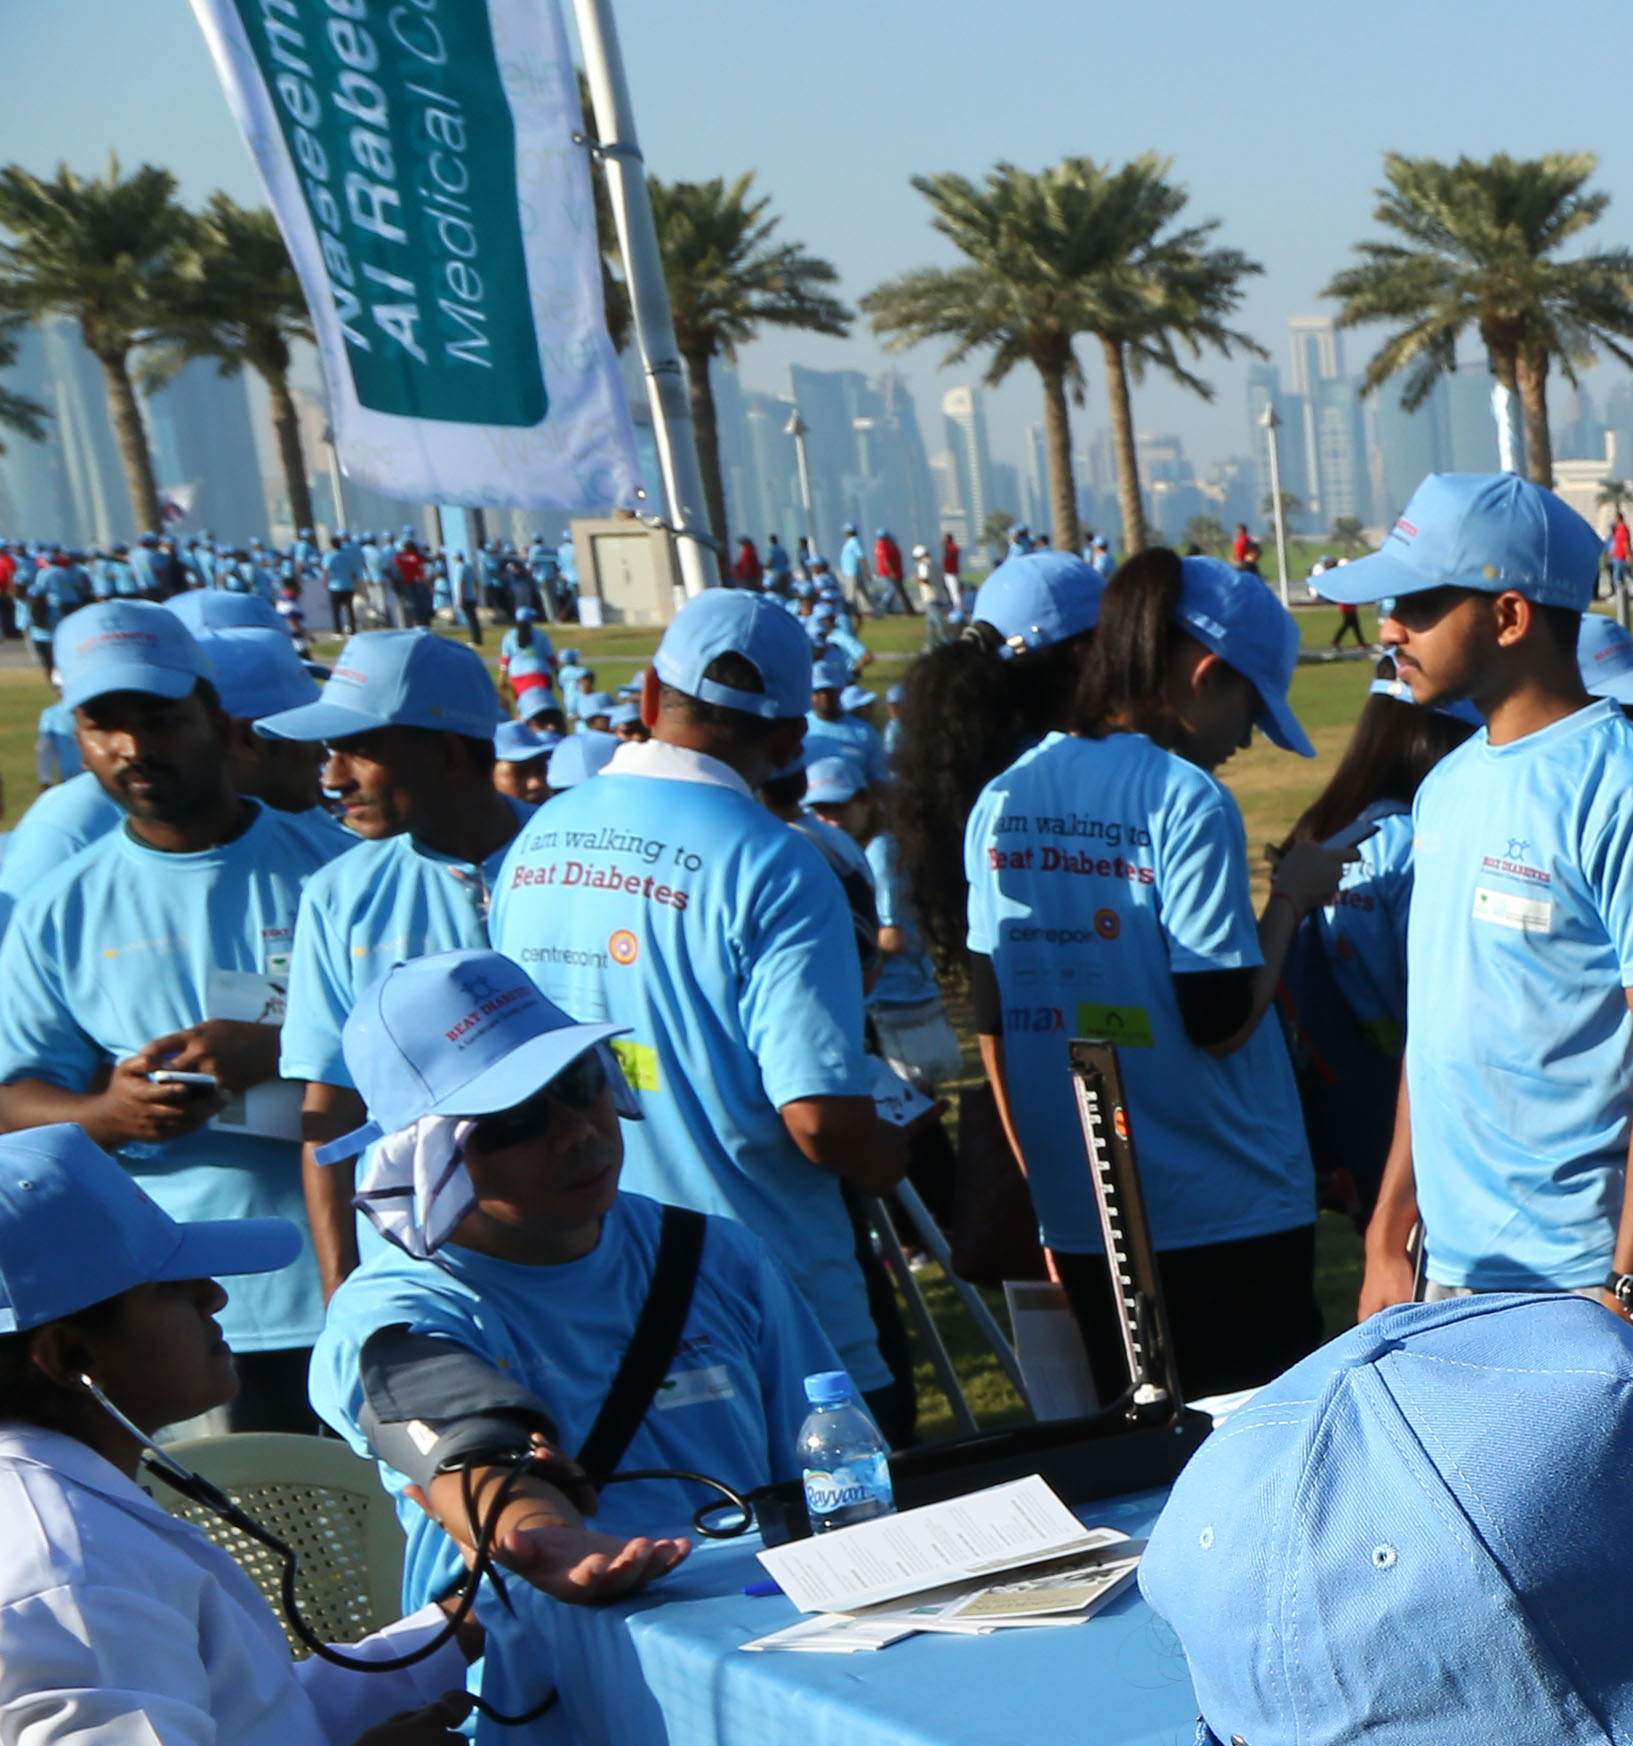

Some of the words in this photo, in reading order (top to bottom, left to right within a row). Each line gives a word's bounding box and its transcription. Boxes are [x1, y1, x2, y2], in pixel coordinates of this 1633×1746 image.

[404, 81, 493, 368] Medical
[362, 262, 427, 364] Al
[565, 827, 668, 864] walking
[672, 845, 703, 872] to
[1036, 812, 1123, 847] walking
[1129, 826, 1152, 847] to
[511, 862, 558, 890] Beat
[561, 860, 690, 912] Diabetes
[1040, 846, 1156, 885] Diabetes
[445, 1010, 482, 1043] BEAT
[1006, 1005, 1066, 1036] max
